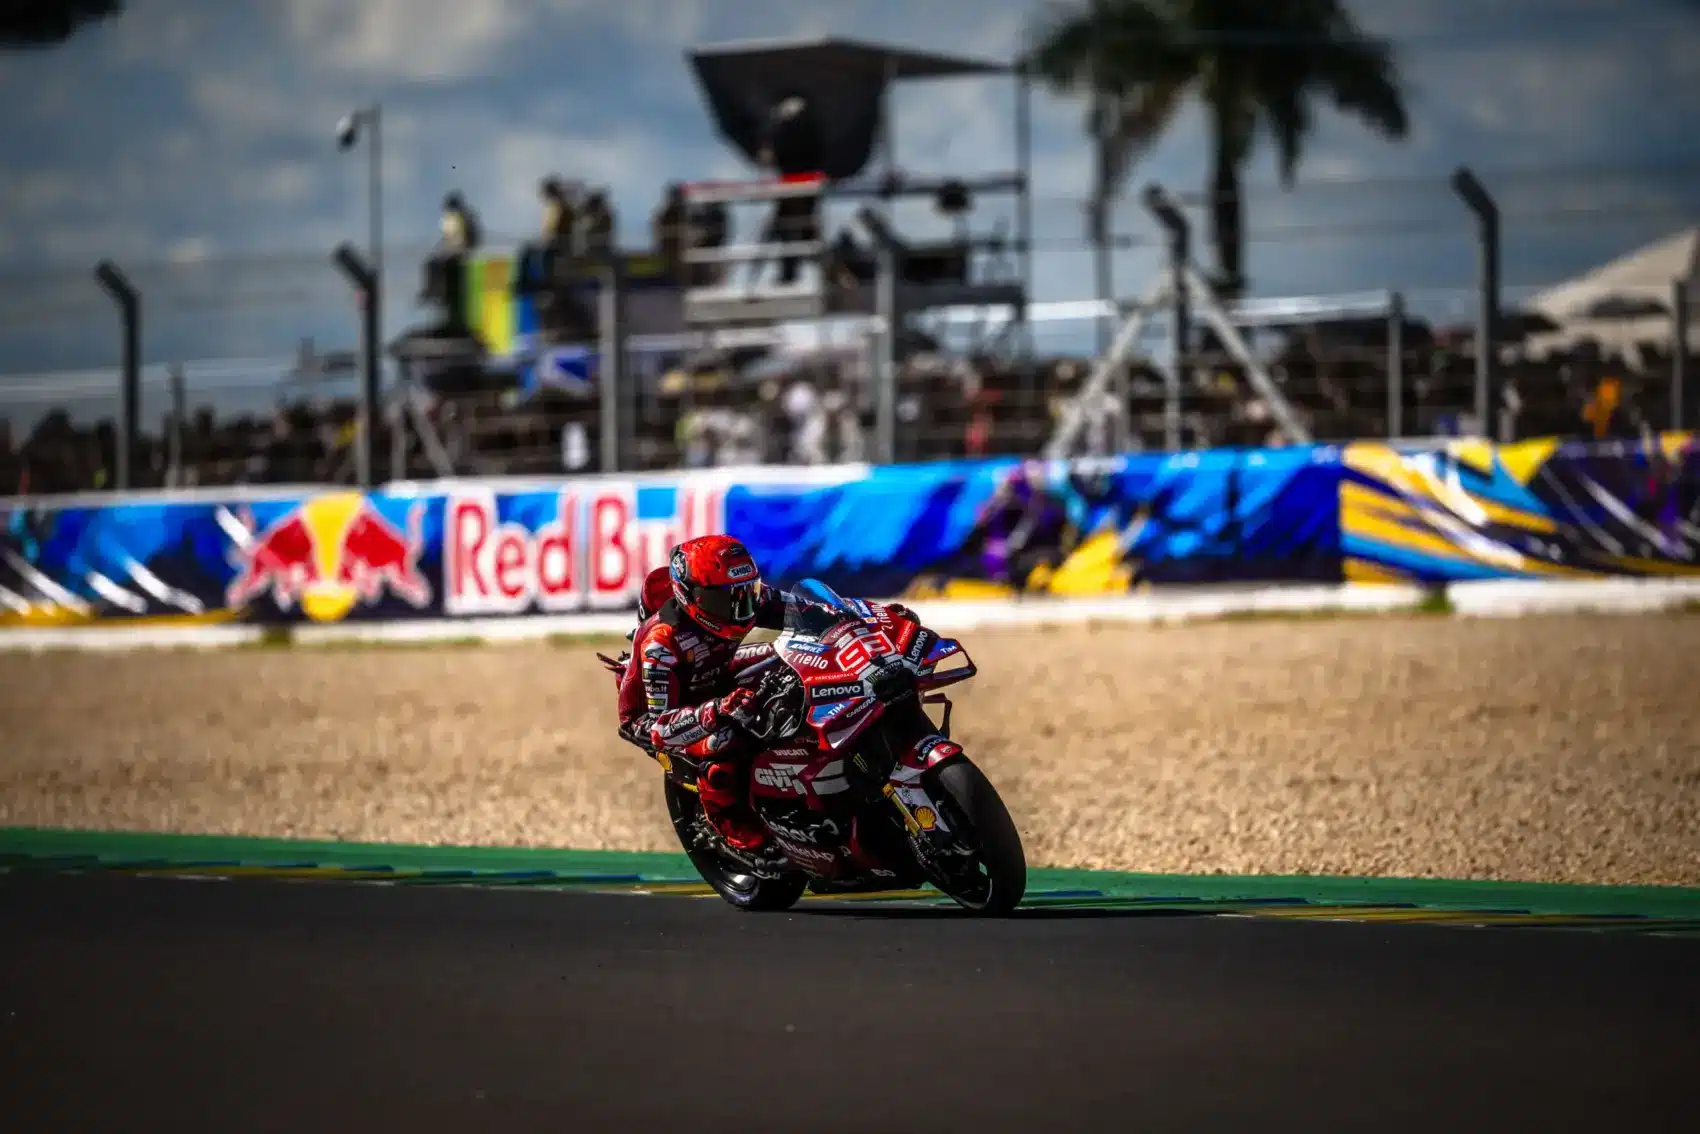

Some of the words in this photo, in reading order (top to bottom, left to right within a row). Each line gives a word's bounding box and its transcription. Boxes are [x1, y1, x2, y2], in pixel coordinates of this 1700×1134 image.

[453, 488, 580, 599] Red
[836, 631, 897, 675] 93
[906, 630, 928, 662] Lenovo
[939, 645, 957, 654] TIM
[793, 653, 829, 669] riello
[812, 684, 861, 698] Lenovo
[827, 703, 846, 717] TIM
[846, 696, 876, 718] CARRERA
[671, 716, 695, 733] Lenovo
[681, 725, 704, 742] Unipol
[773, 748, 809, 756] DUCATI
[917, 736, 947, 762] Leno
